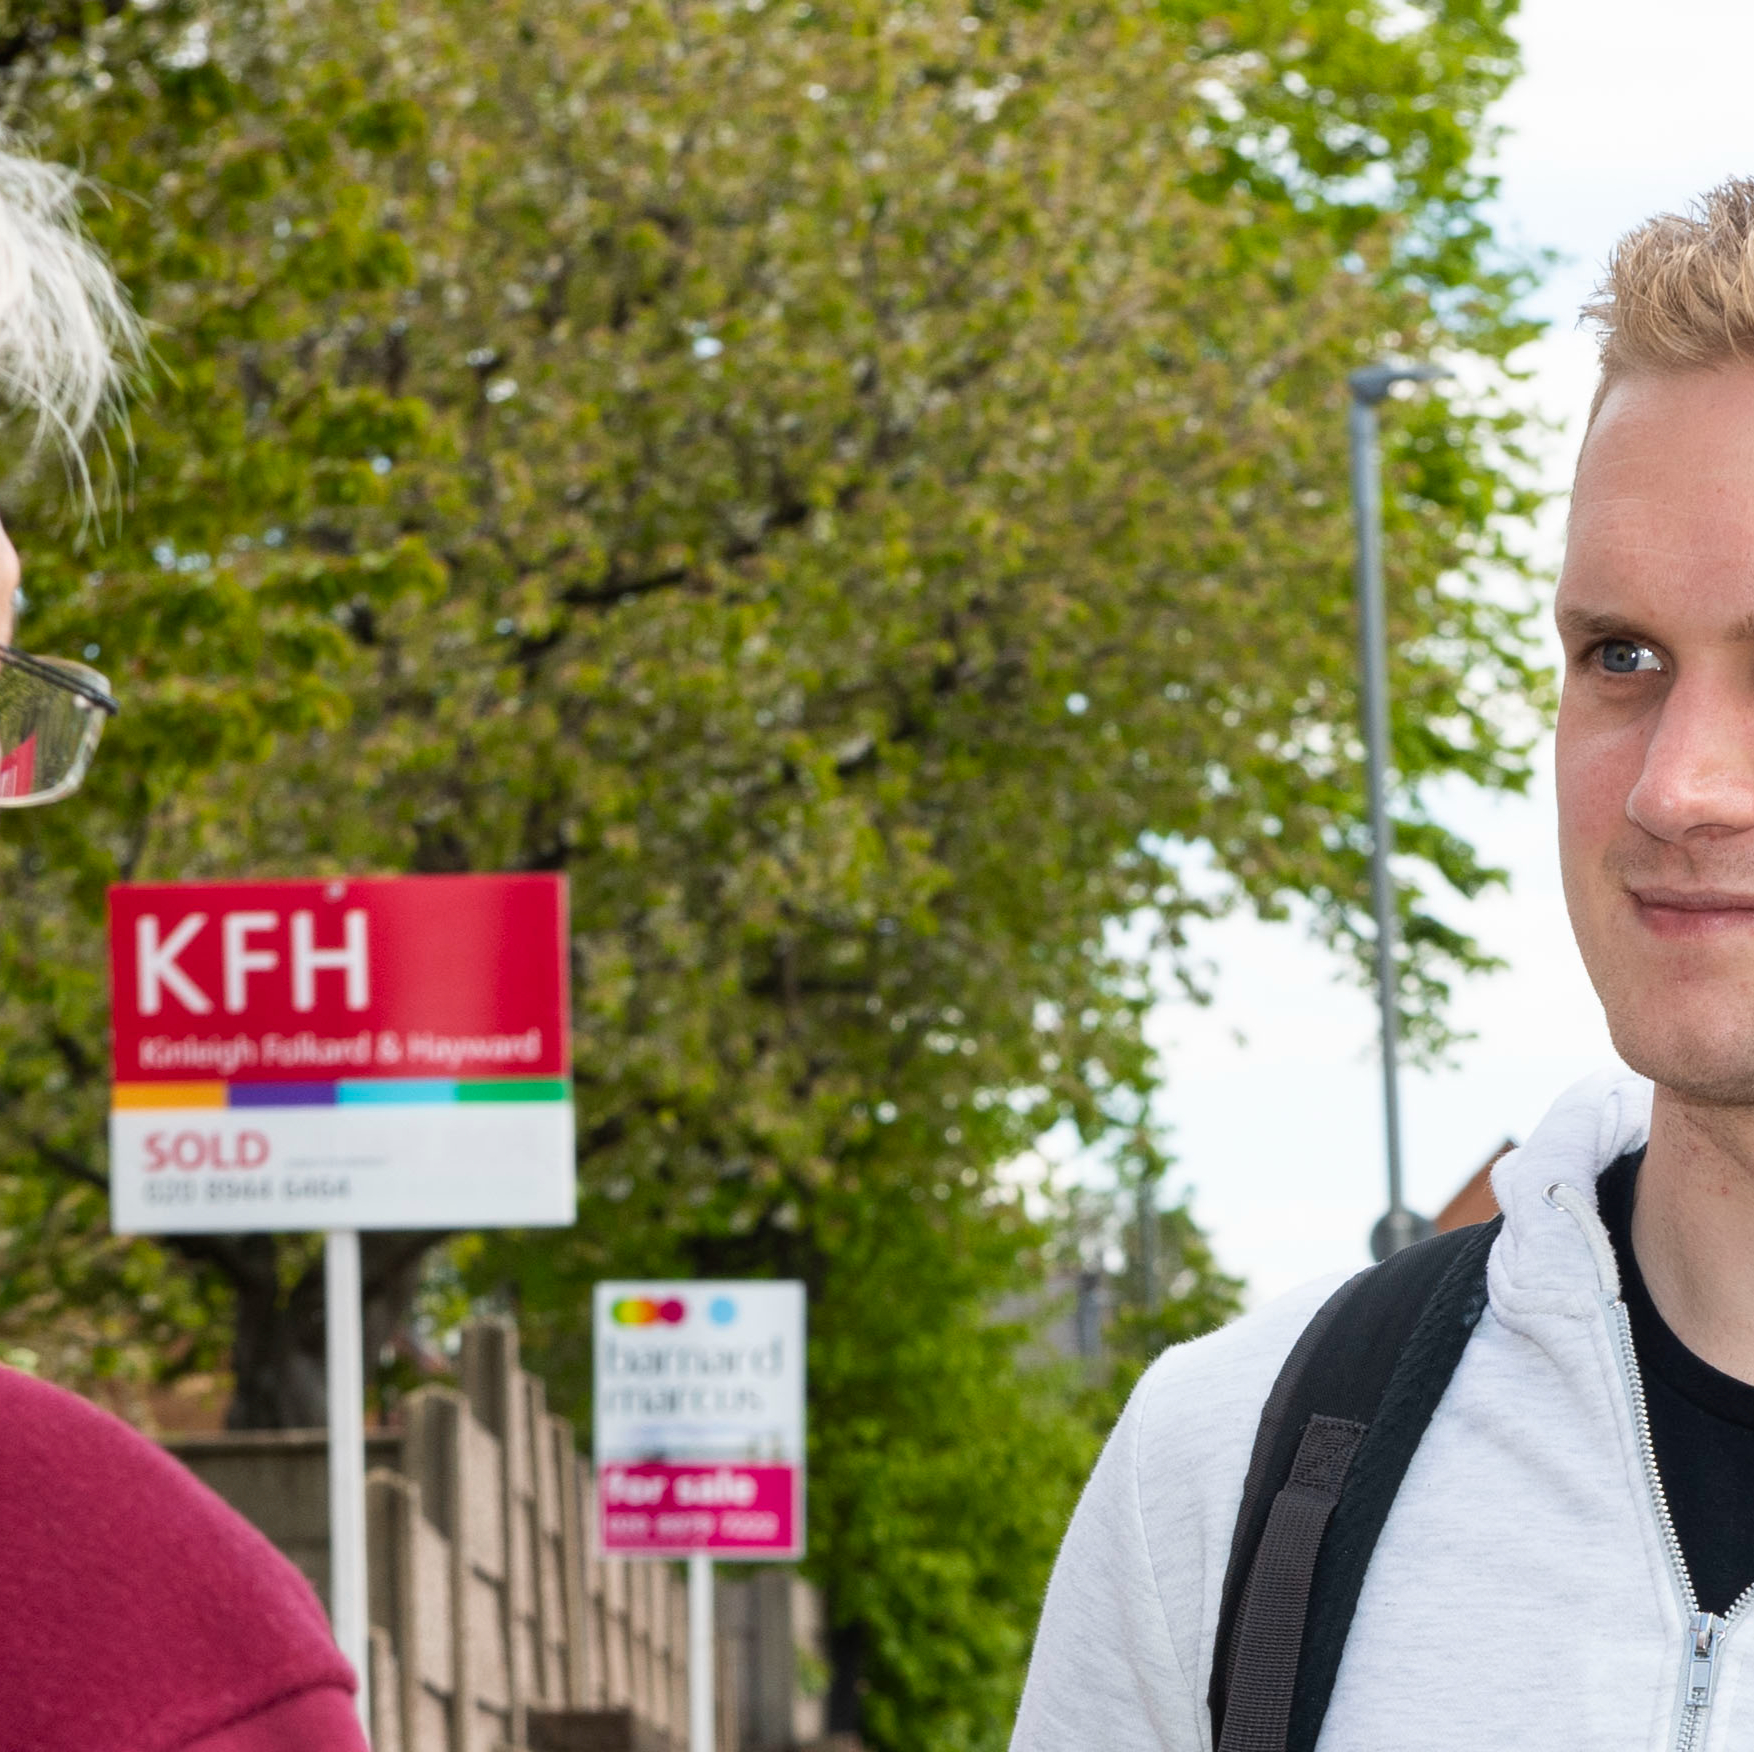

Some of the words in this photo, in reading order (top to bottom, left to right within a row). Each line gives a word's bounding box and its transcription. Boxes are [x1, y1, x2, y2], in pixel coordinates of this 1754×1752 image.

[136, 909, 370, 1016] KFH
[140, 1034, 257, 1074] Kinleigh
[262, 1031, 371, 1066] Folkard
[377, 1031, 403, 1065] &
[407, 1028, 541, 1070] Hayward
[143, 1130, 270, 1173] SOLD
[605, 1336, 783, 1377] barnard
[605, 1386, 764, 1414] marcus
[605, 1468, 669, 1506] for
[673, 1467, 758, 1507] sale
